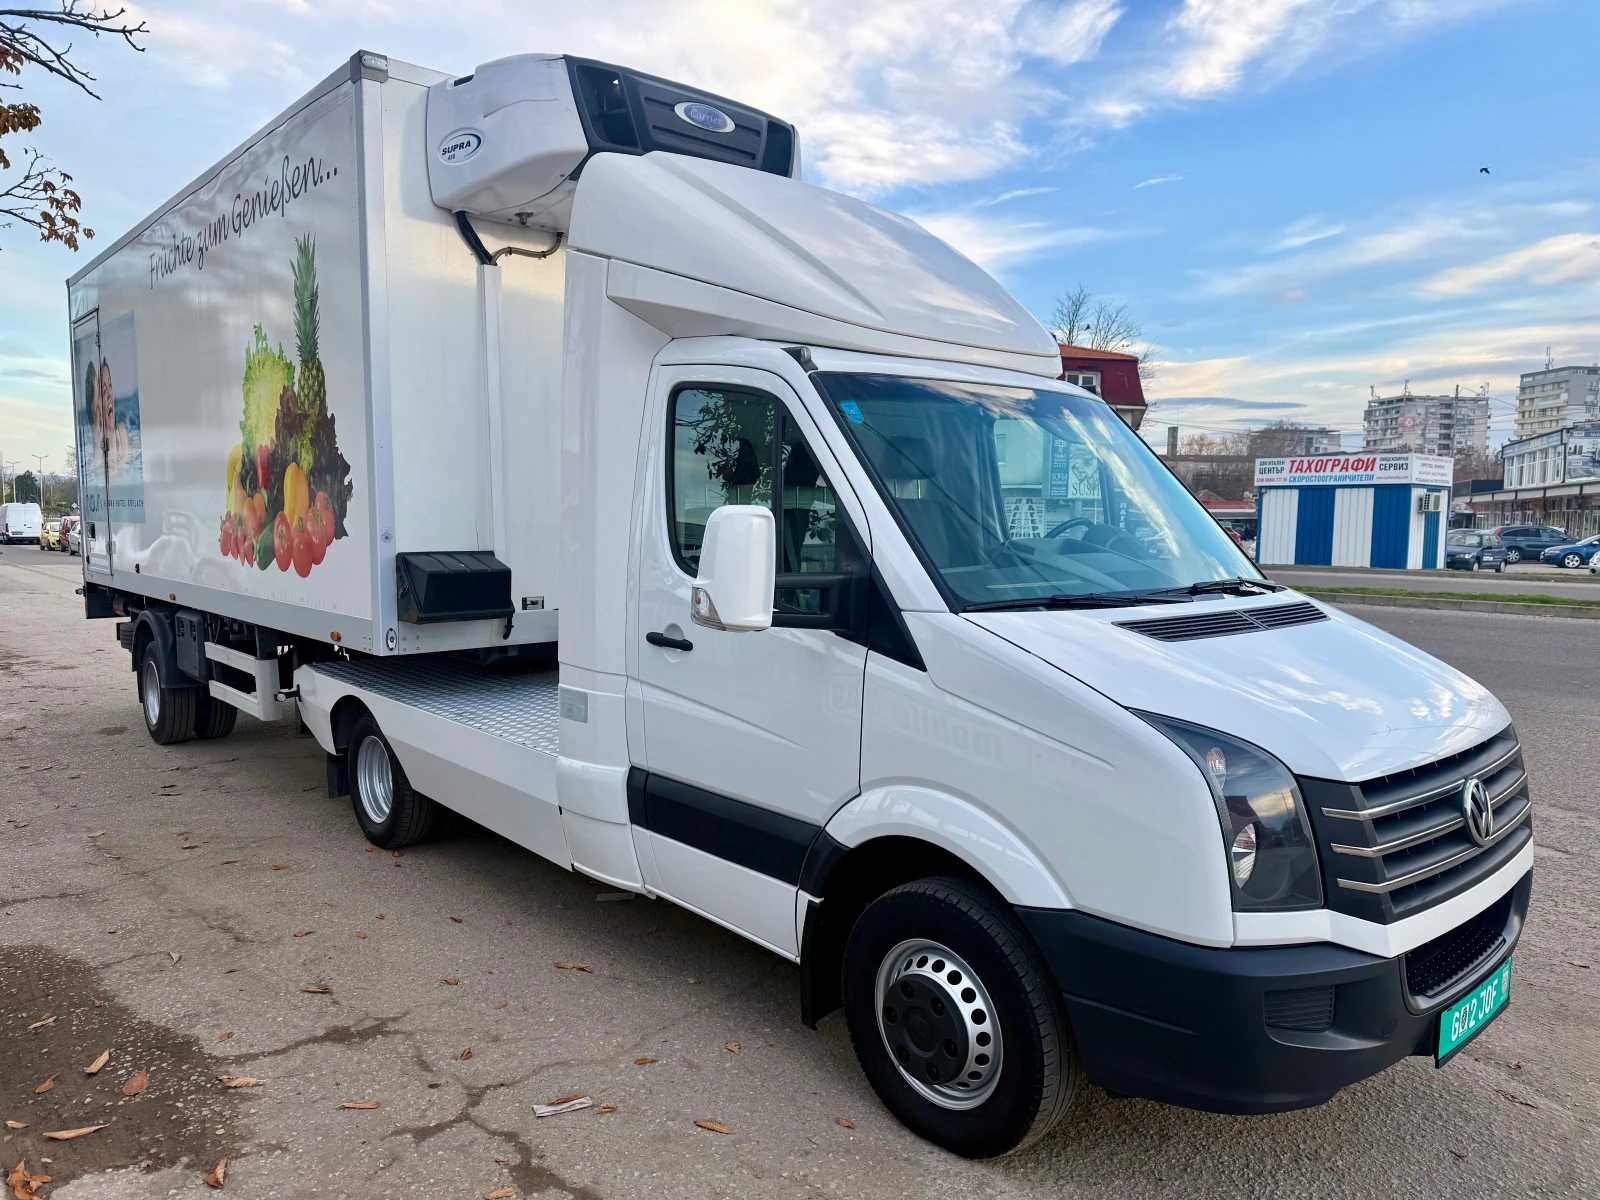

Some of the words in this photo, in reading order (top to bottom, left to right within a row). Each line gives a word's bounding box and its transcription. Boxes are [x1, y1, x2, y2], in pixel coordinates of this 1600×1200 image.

[690, 108, 722, 125] Carrier
[441, 140, 471, 155] SUPRA
[149, 231, 195, 290] Früchte
[198, 213, 230, 270] zum
[1258, 467, 1285, 475] ЦЕНТЪР
[1288, 457, 1377, 473] ТАХОГРАФИ
[1288, 474, 1375, 483] СКОРОСТООГРАНИЧИТЕЛИ
